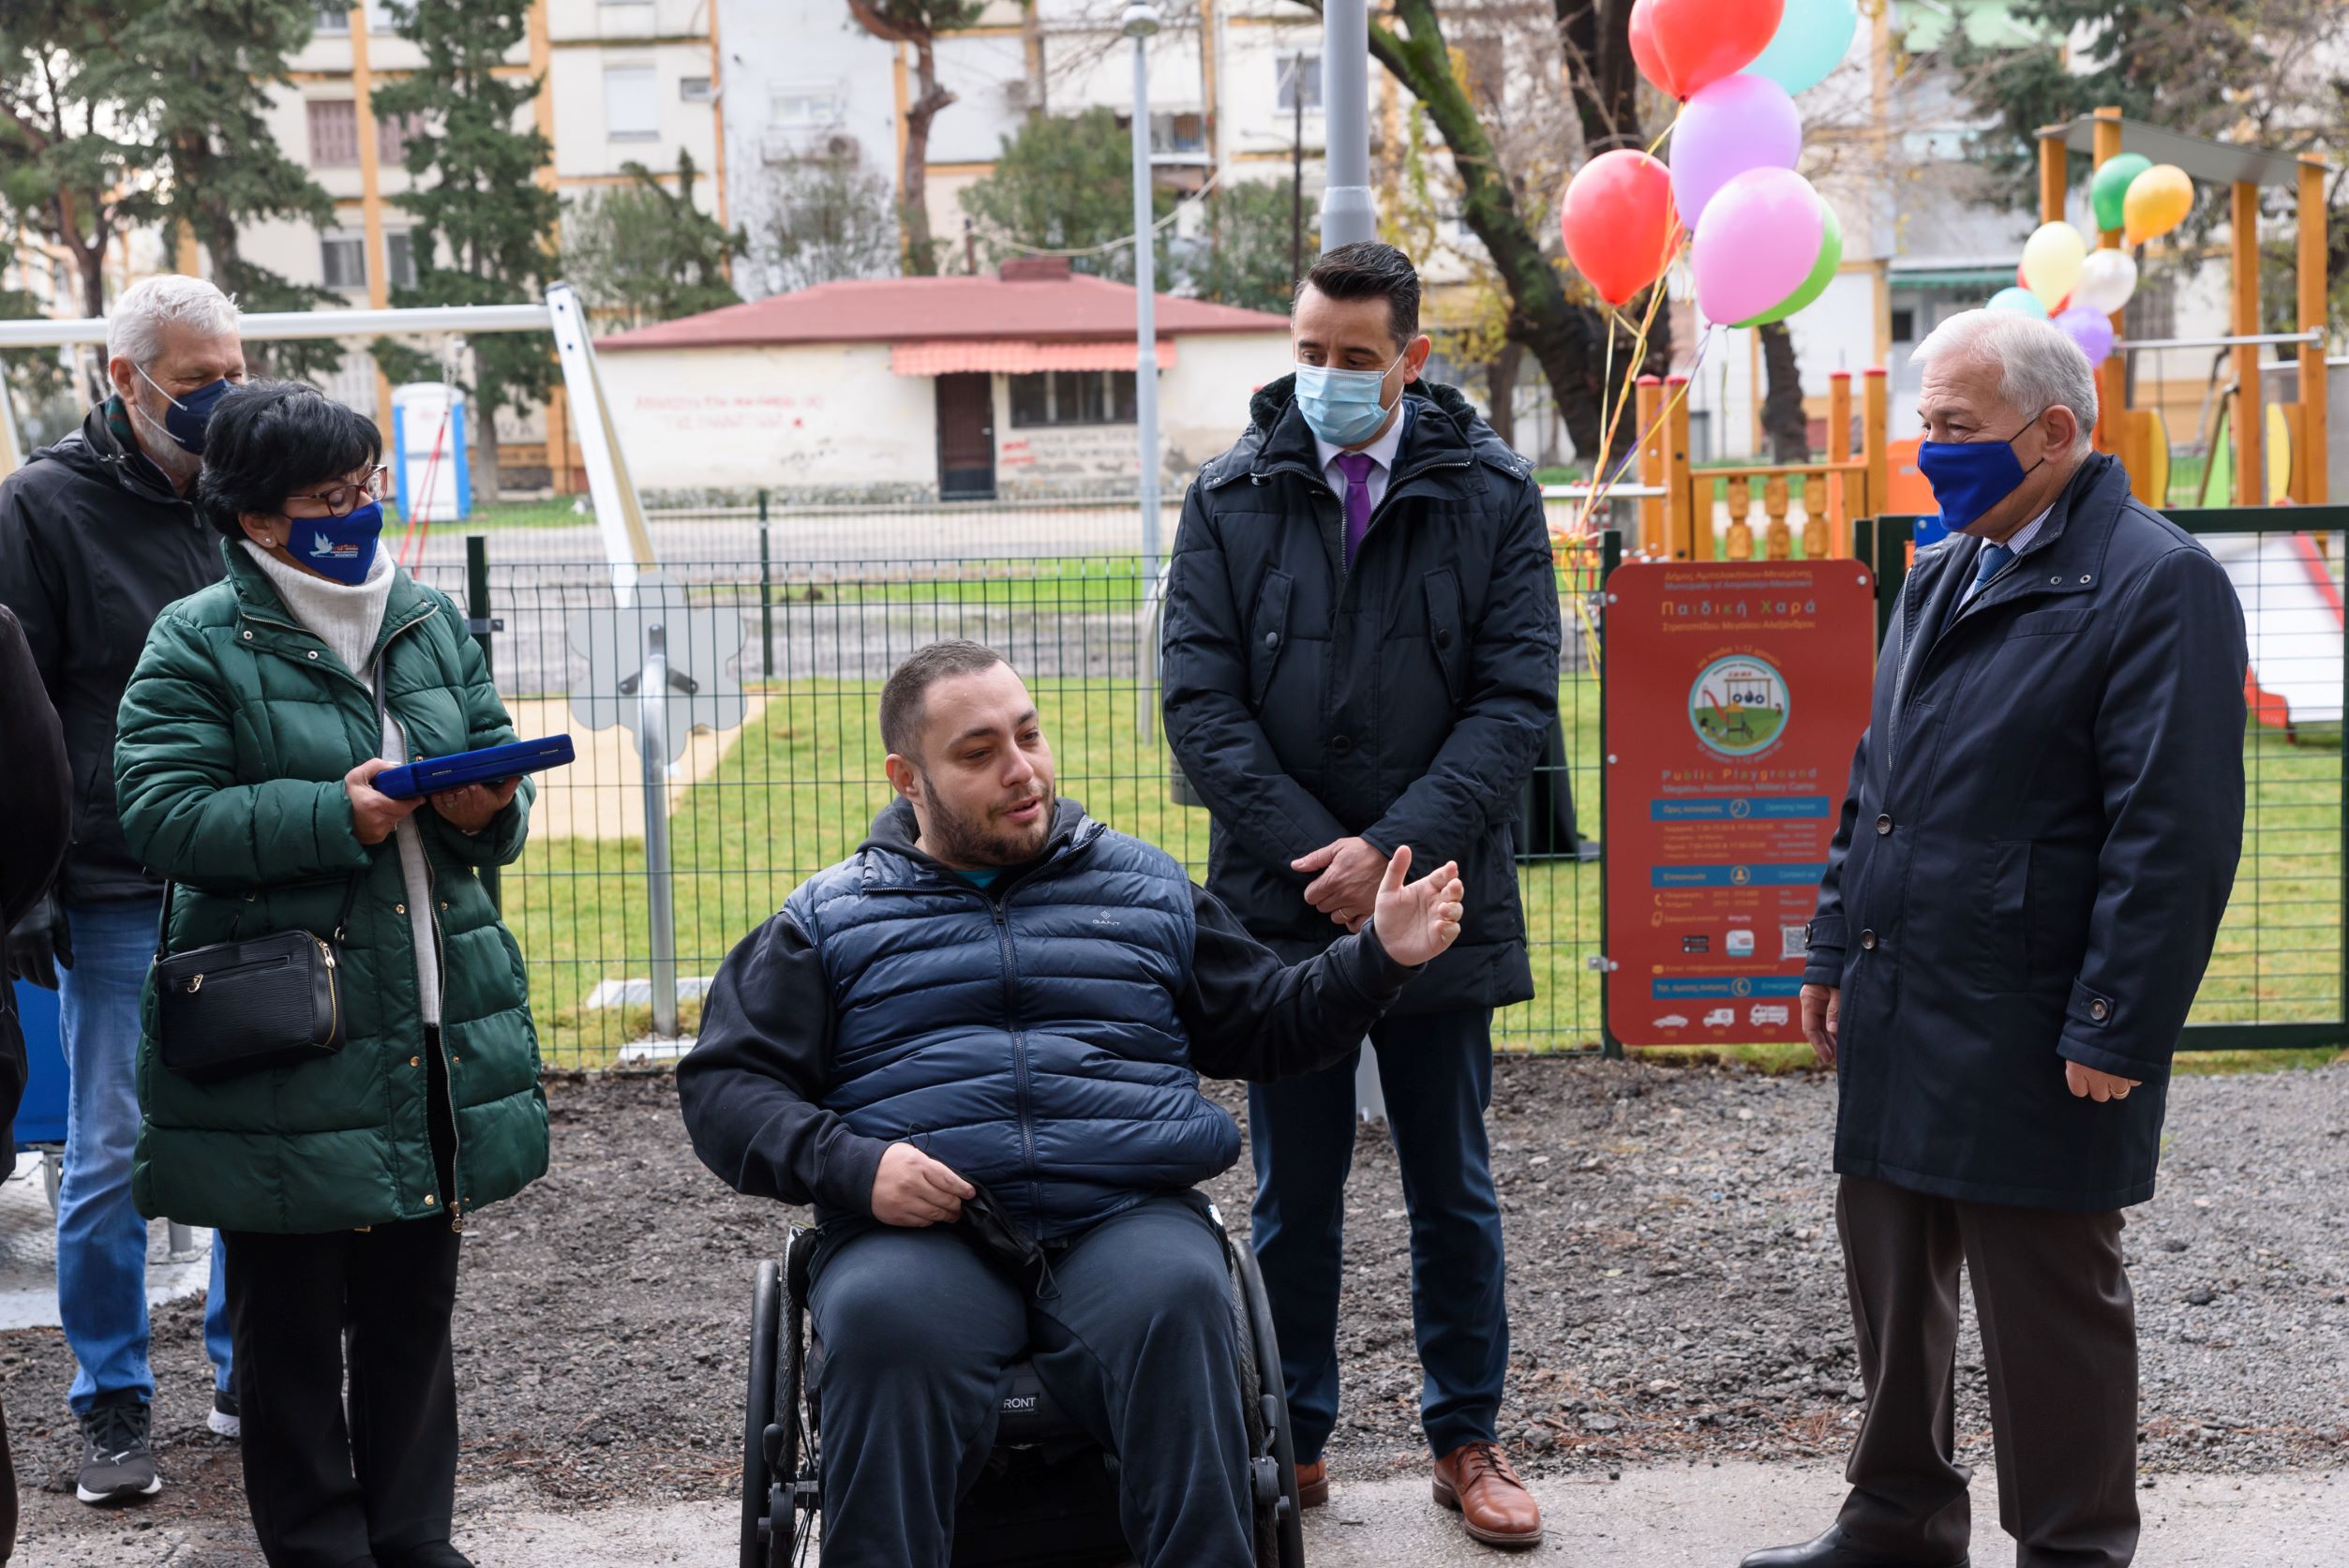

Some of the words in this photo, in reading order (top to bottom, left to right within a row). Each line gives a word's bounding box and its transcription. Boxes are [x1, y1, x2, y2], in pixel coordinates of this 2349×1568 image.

[1662, 600, 1747, 618] Παιδική
[1760, 599, 1816, 616] Χαρά
[1662, 769, 1714, 781] Public
[1723, 767, 1817, 783] Playground
[1092, 918, 1121, 927] GANT
[1003, 1396, 1037, 1409] RONT
